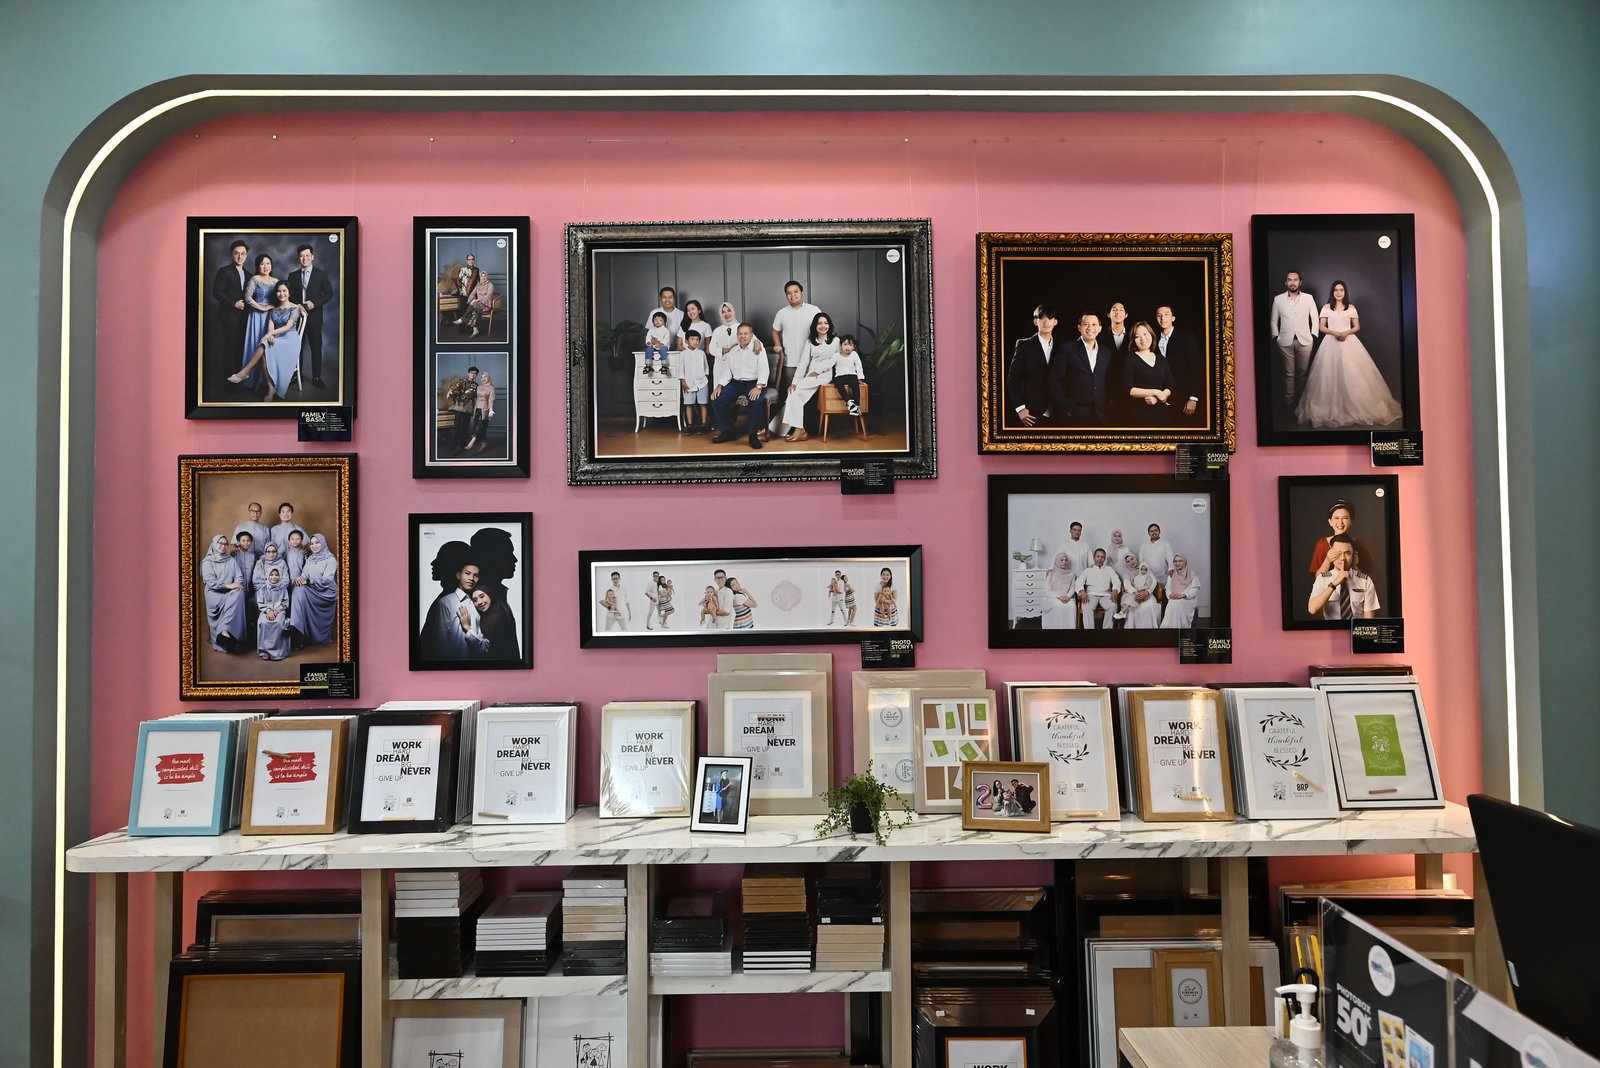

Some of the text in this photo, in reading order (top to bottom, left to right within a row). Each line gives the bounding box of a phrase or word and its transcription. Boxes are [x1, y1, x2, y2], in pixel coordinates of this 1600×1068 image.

[1052, 732, 1085, 741] thankful
[1154, 736, 1190, 744] DREAM
[1267, 736, 1303, 745] thankful
[497, 750, 529, 758] DREAM
[1183, 750, 1216, 759] NEVER
[646, 757, 674, 765] NEVER
[521, 762, 550, 770] NEVER
[400, 767, 431, 775] NEVER
[1337, 982, 1371, 1015] PHOTOBOX
[1337, 994, 1372, 1046] 50K
